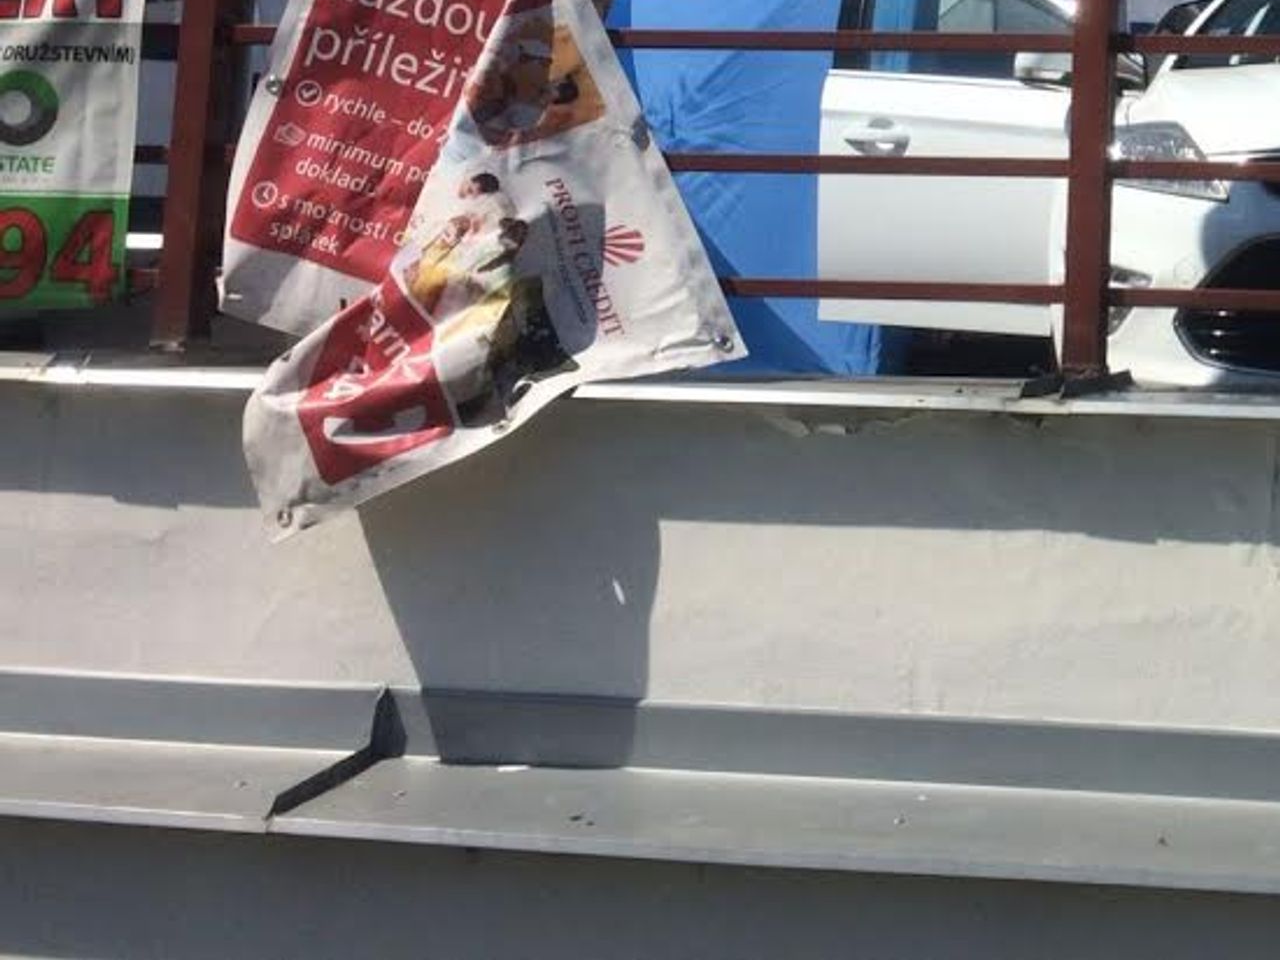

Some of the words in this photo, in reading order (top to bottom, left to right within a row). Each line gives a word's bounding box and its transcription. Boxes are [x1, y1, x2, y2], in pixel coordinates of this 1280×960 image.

[323, 93, 386, 124] rychle
[407, 116, 434, 139] do
[306, 132, 404, 176] minimum
[573, 252, 626, 335] CREDIT
